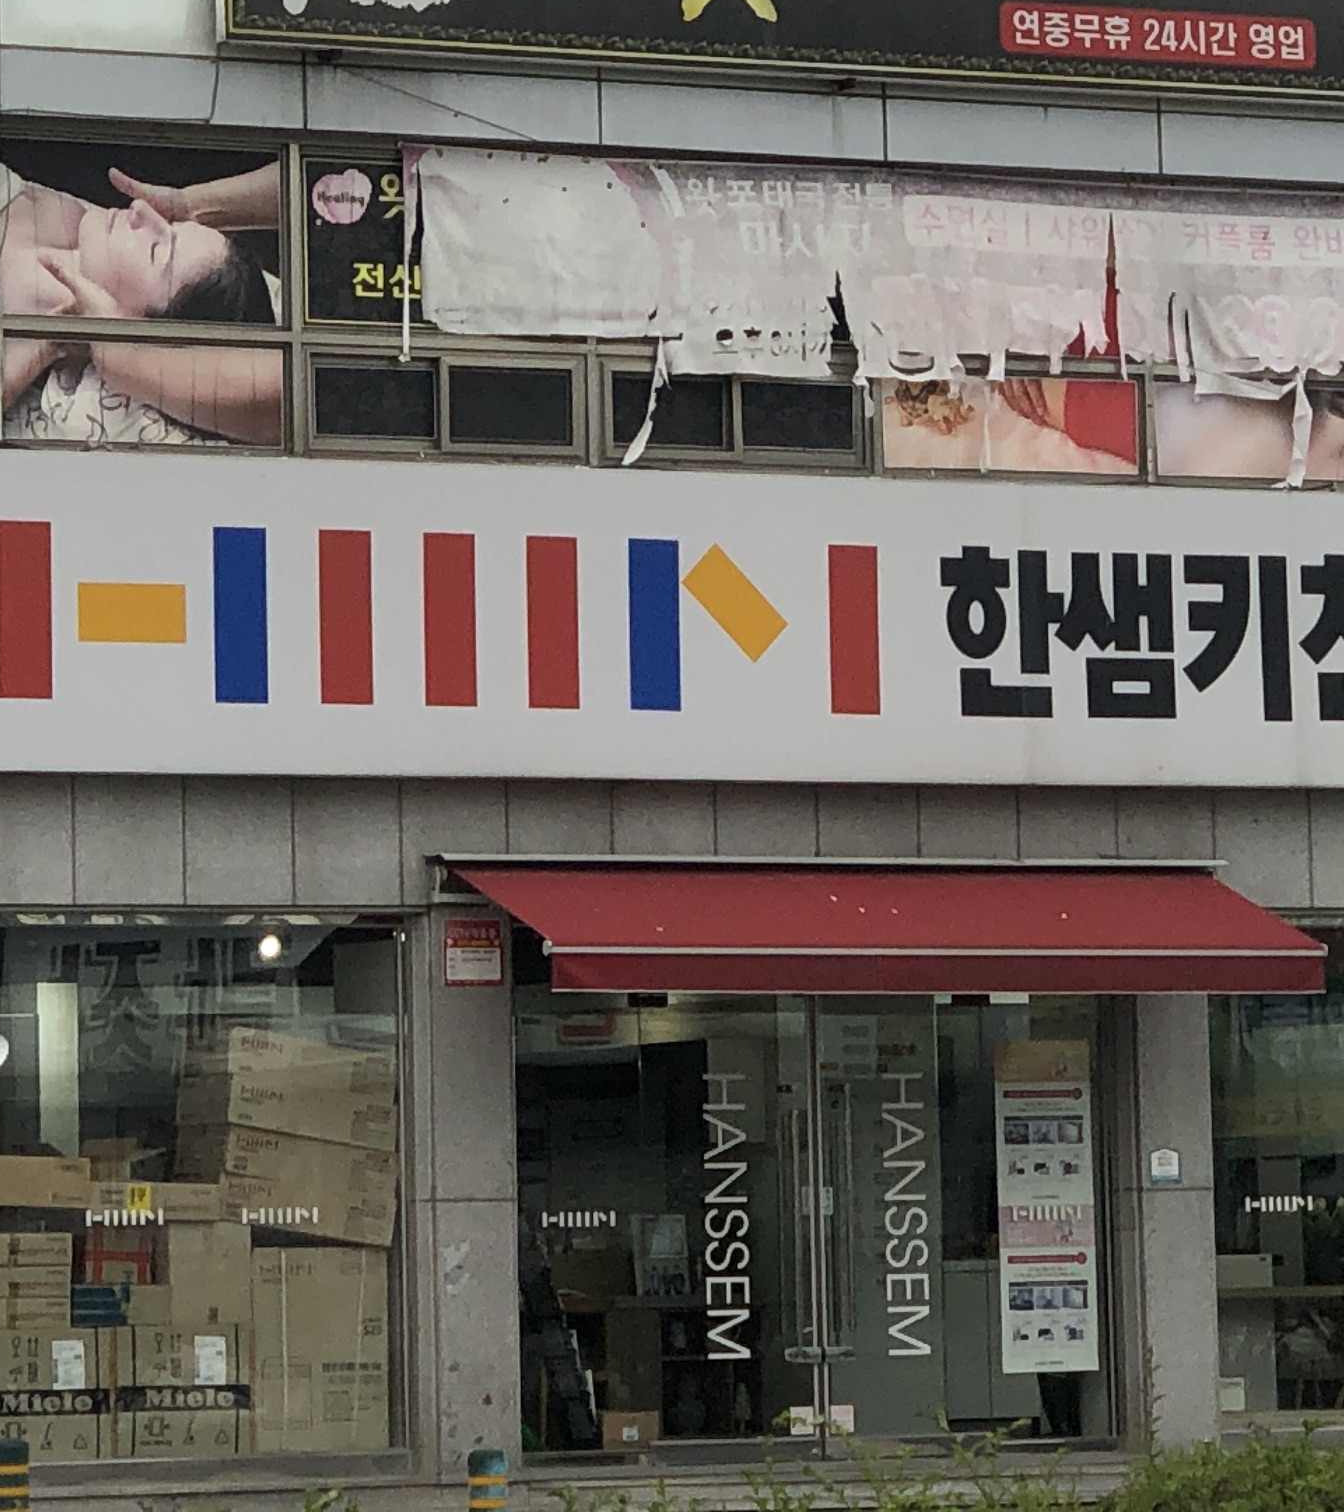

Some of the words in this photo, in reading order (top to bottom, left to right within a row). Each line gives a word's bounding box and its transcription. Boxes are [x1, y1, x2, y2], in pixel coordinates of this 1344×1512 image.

[1012, 8, 1132, 52] 연중무휴
[1143, 17, 1237, 59] 24시간
[1248, 22, 1306, 62] 영업
[316, 190, 366, 208] Healing
[701, 1072, 752, 1362] HANSSEM
[881, 1072, 933, 1359] HANSSEM
[1, 1390, 94, 1414] Miele
[144, 1387, 235, 1410] Miele
